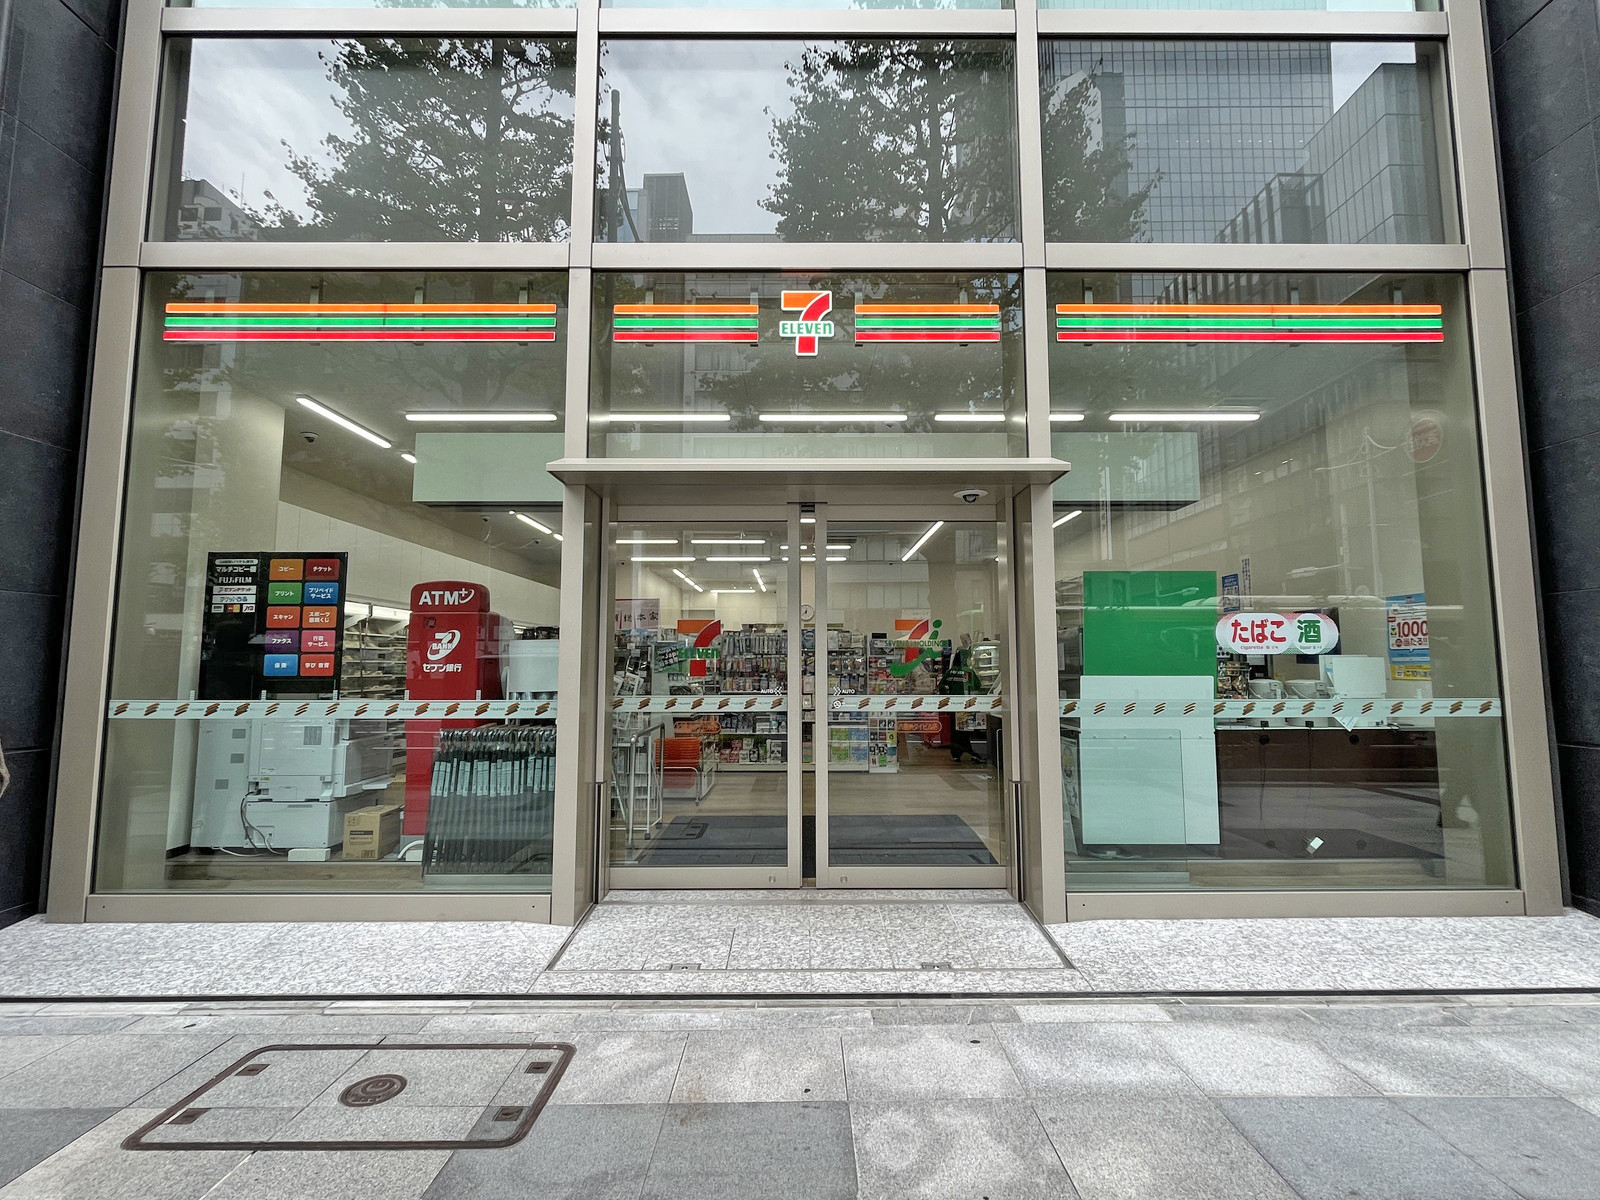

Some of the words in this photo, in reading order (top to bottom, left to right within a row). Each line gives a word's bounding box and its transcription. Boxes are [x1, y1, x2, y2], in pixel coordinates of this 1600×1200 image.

[1231, 618, 1287, 643] たばこ
[1297, 619, 1322, 643] 酒
